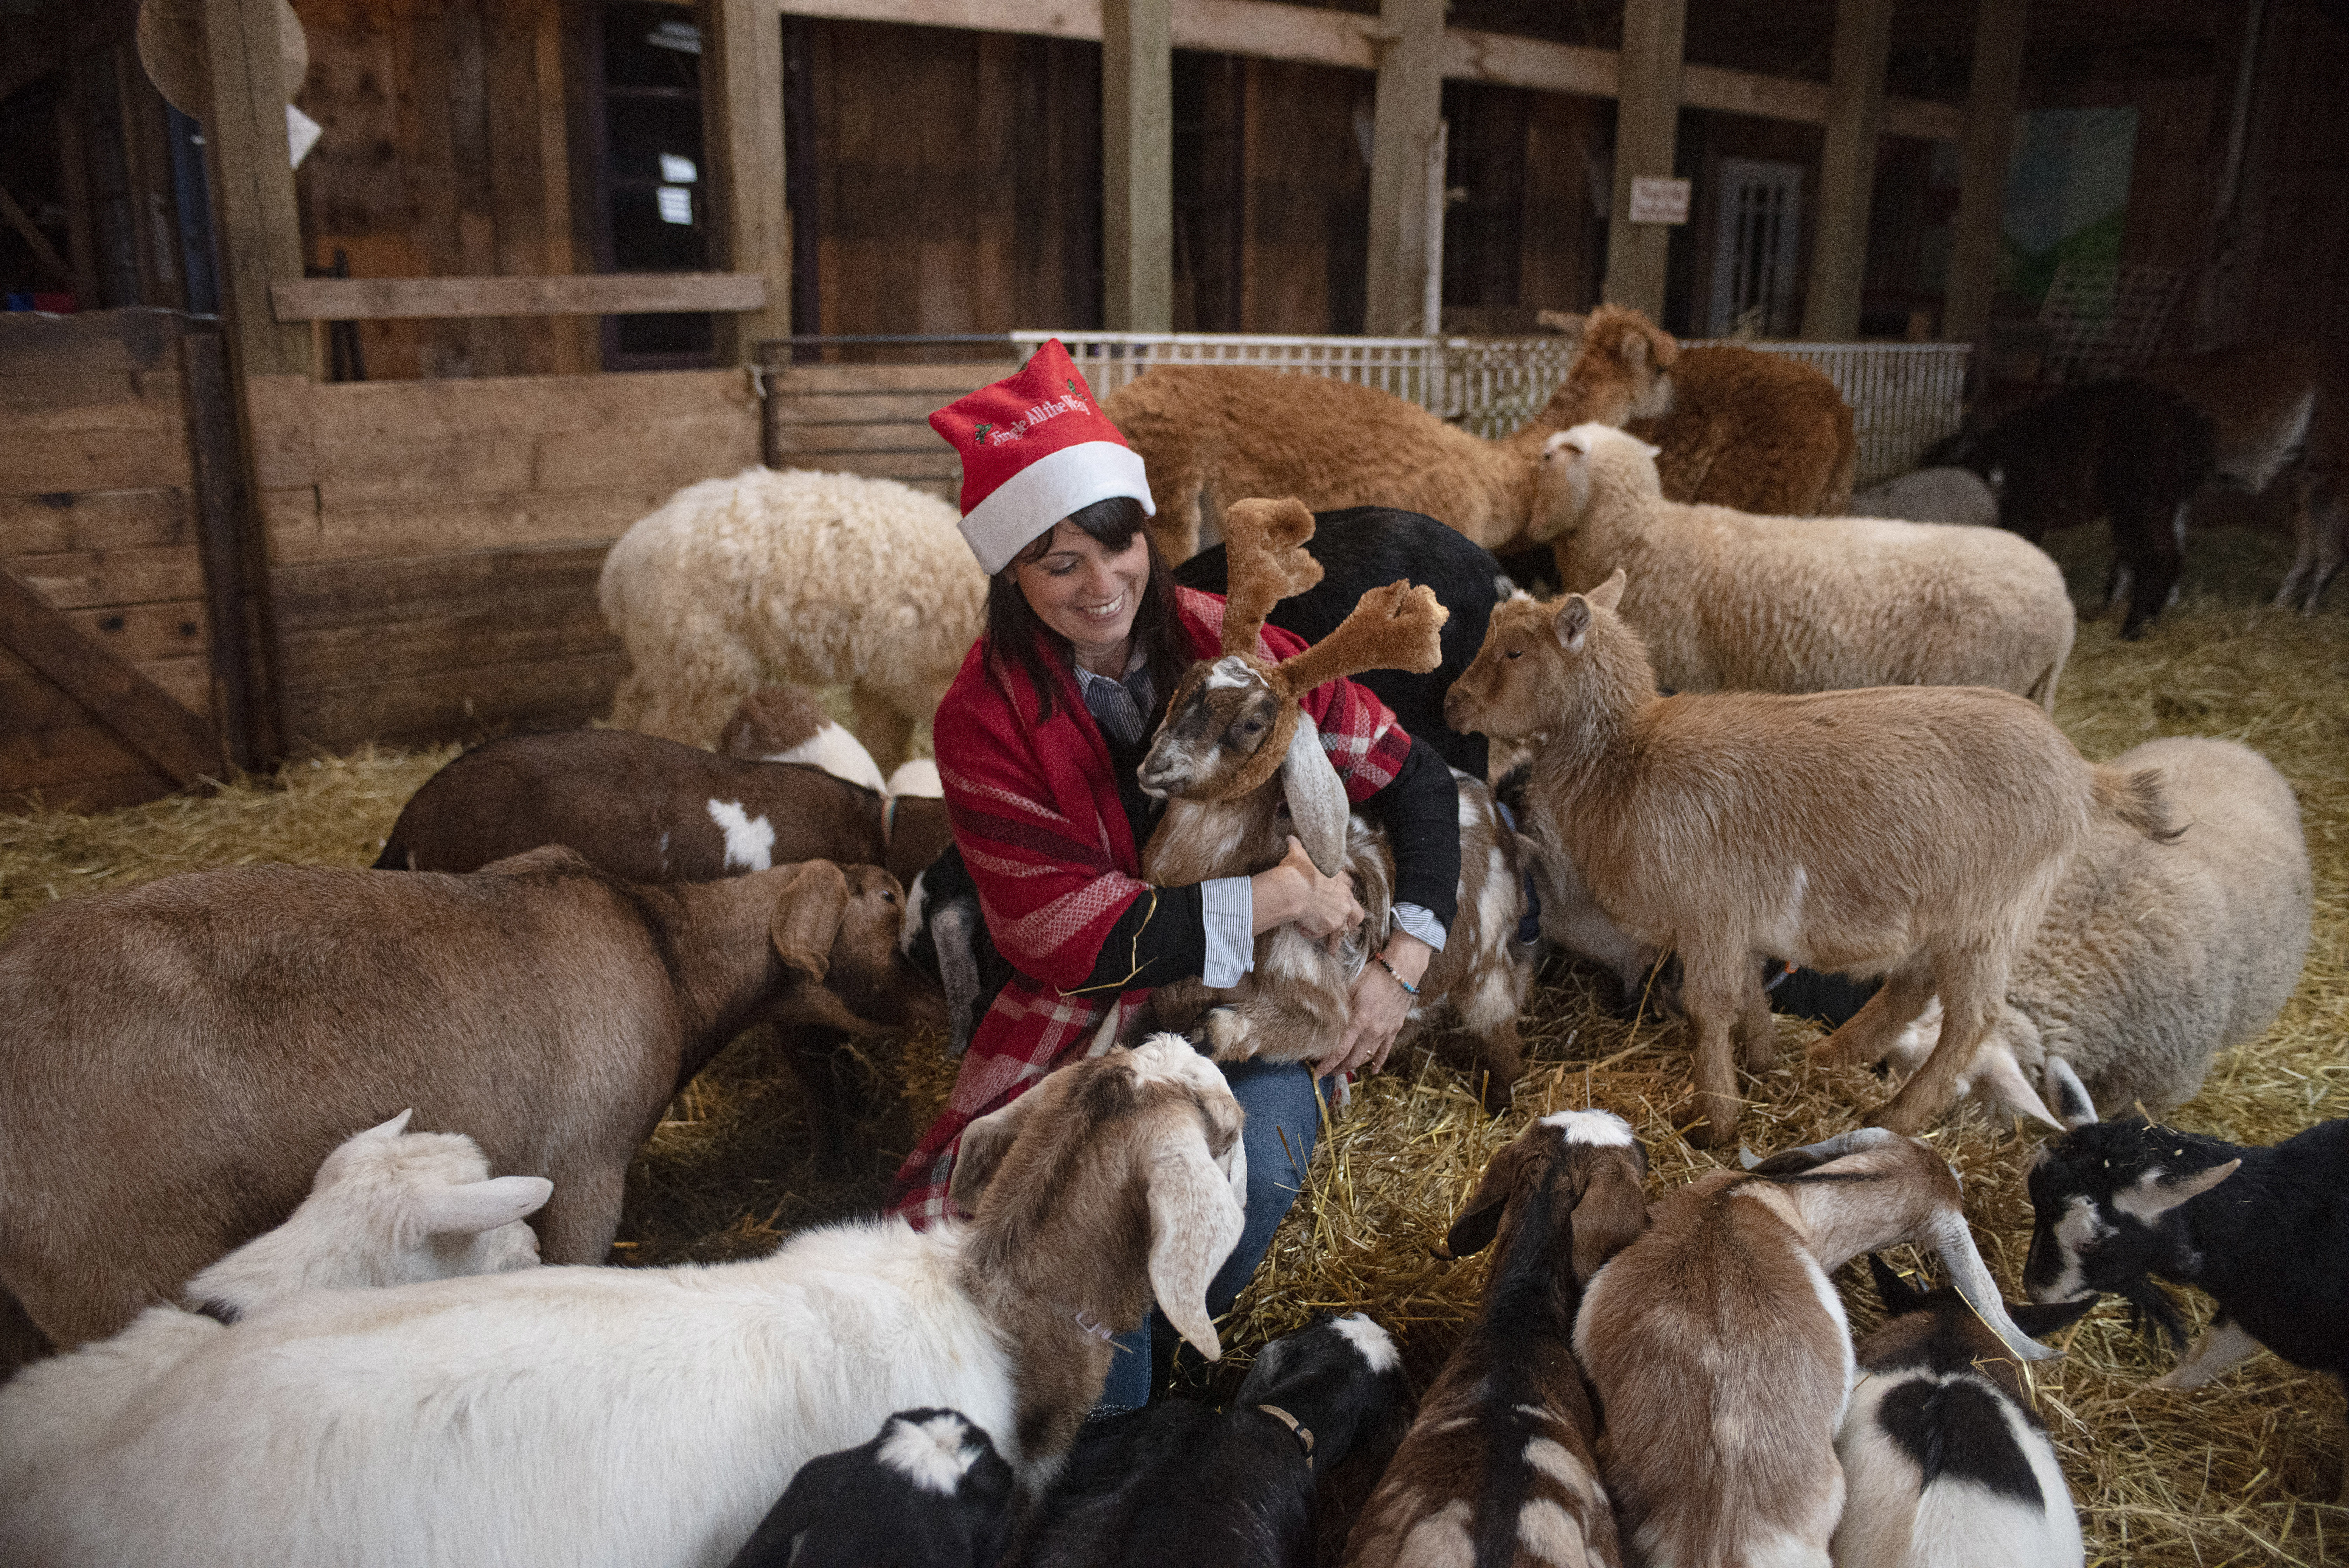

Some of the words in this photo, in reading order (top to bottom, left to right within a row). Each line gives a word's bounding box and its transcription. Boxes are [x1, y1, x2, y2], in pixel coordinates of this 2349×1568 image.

[990, 420, 1029, 446] Jingle
[1025, 406, 1049, 426] All
[1042, 401, 1068, 418] the
[1060, 395, 1090, 415] Way
